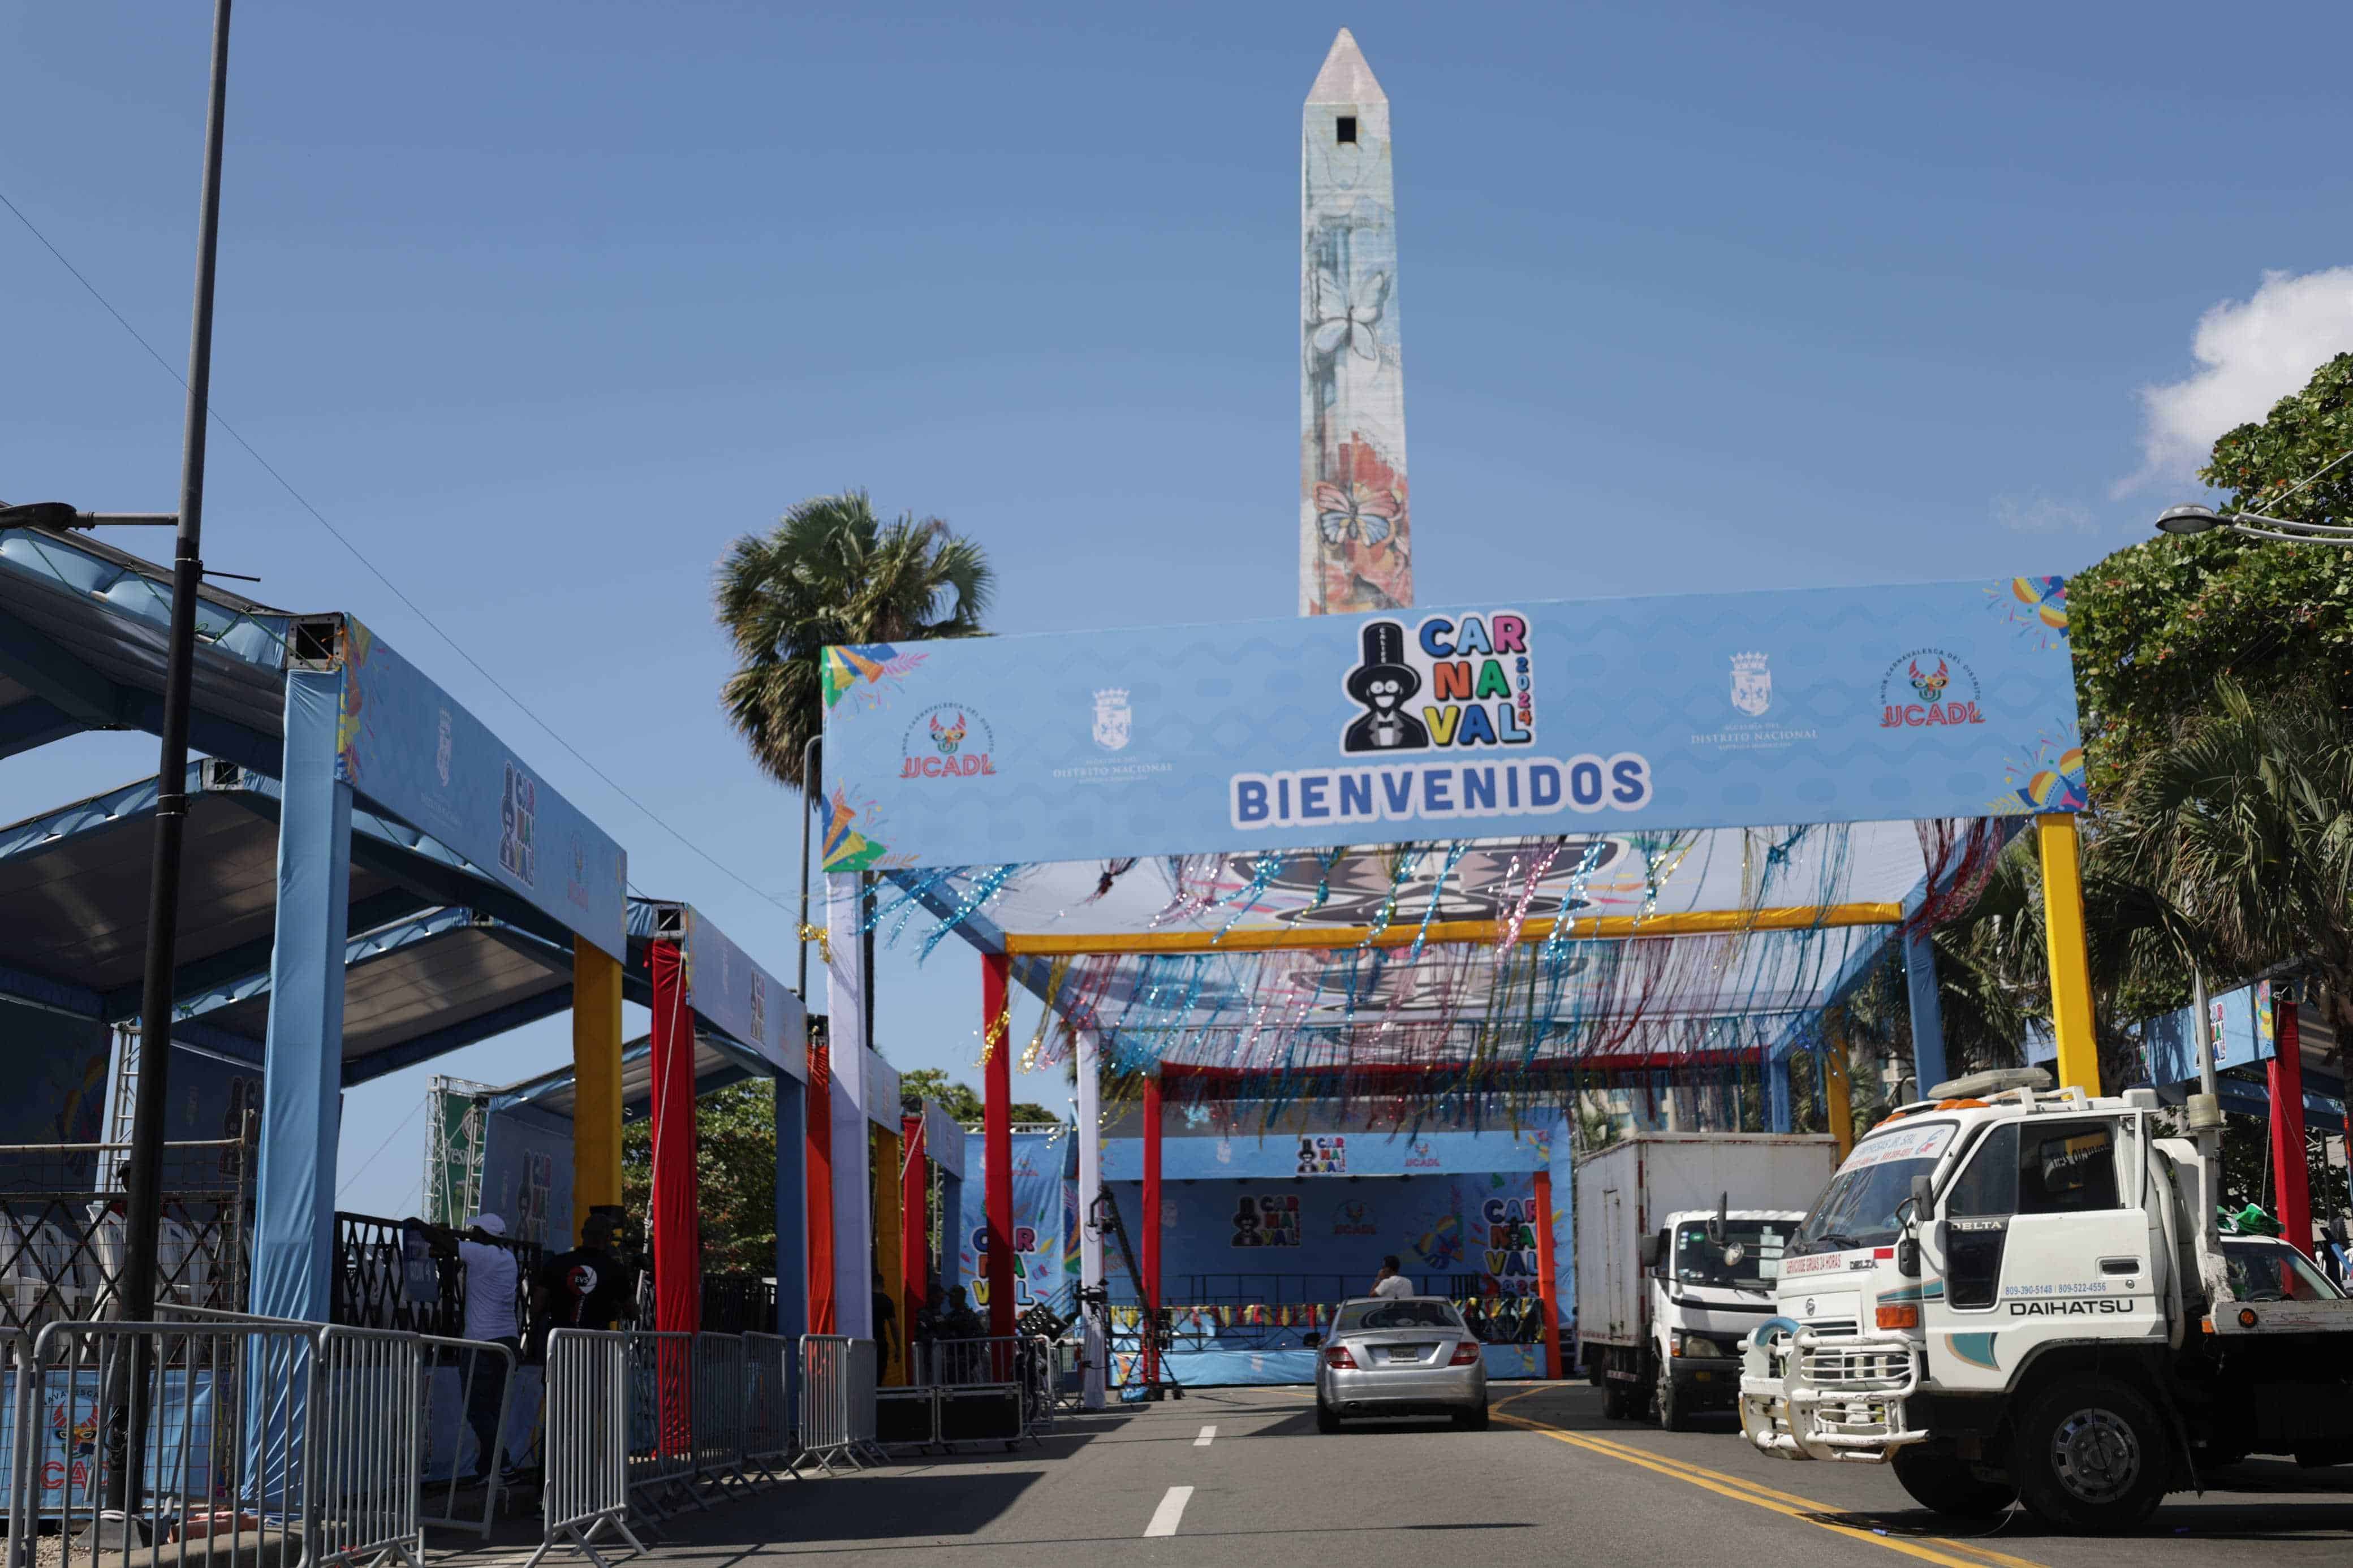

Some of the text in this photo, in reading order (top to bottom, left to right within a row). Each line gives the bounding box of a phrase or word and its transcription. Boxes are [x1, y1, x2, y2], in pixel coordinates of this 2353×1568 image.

[1420, 616, 1526, 658] CAR
[1433, 659, 1511, 701] NA
[1516, 656, 1532, 726] 2024
[1422, 703, 1532, 746] VAL
[1691, 729, 1818, 743] DISTRITO NACIONAL
[1238, 760, 1645, 822] BIENVENIDOS
[1951, 1220, 2002, 1232] DELTA
[972, 1227, 1035, 1252] CR
[1850, 1259, 1878, 1270] DELTA
[972, 1280, 1035, 1306] VL
[2005, 1282, 2106, 1295] 809-390-5148 809-522-4556
[2010, 1299, 2134, 1316] DAIHATSU
